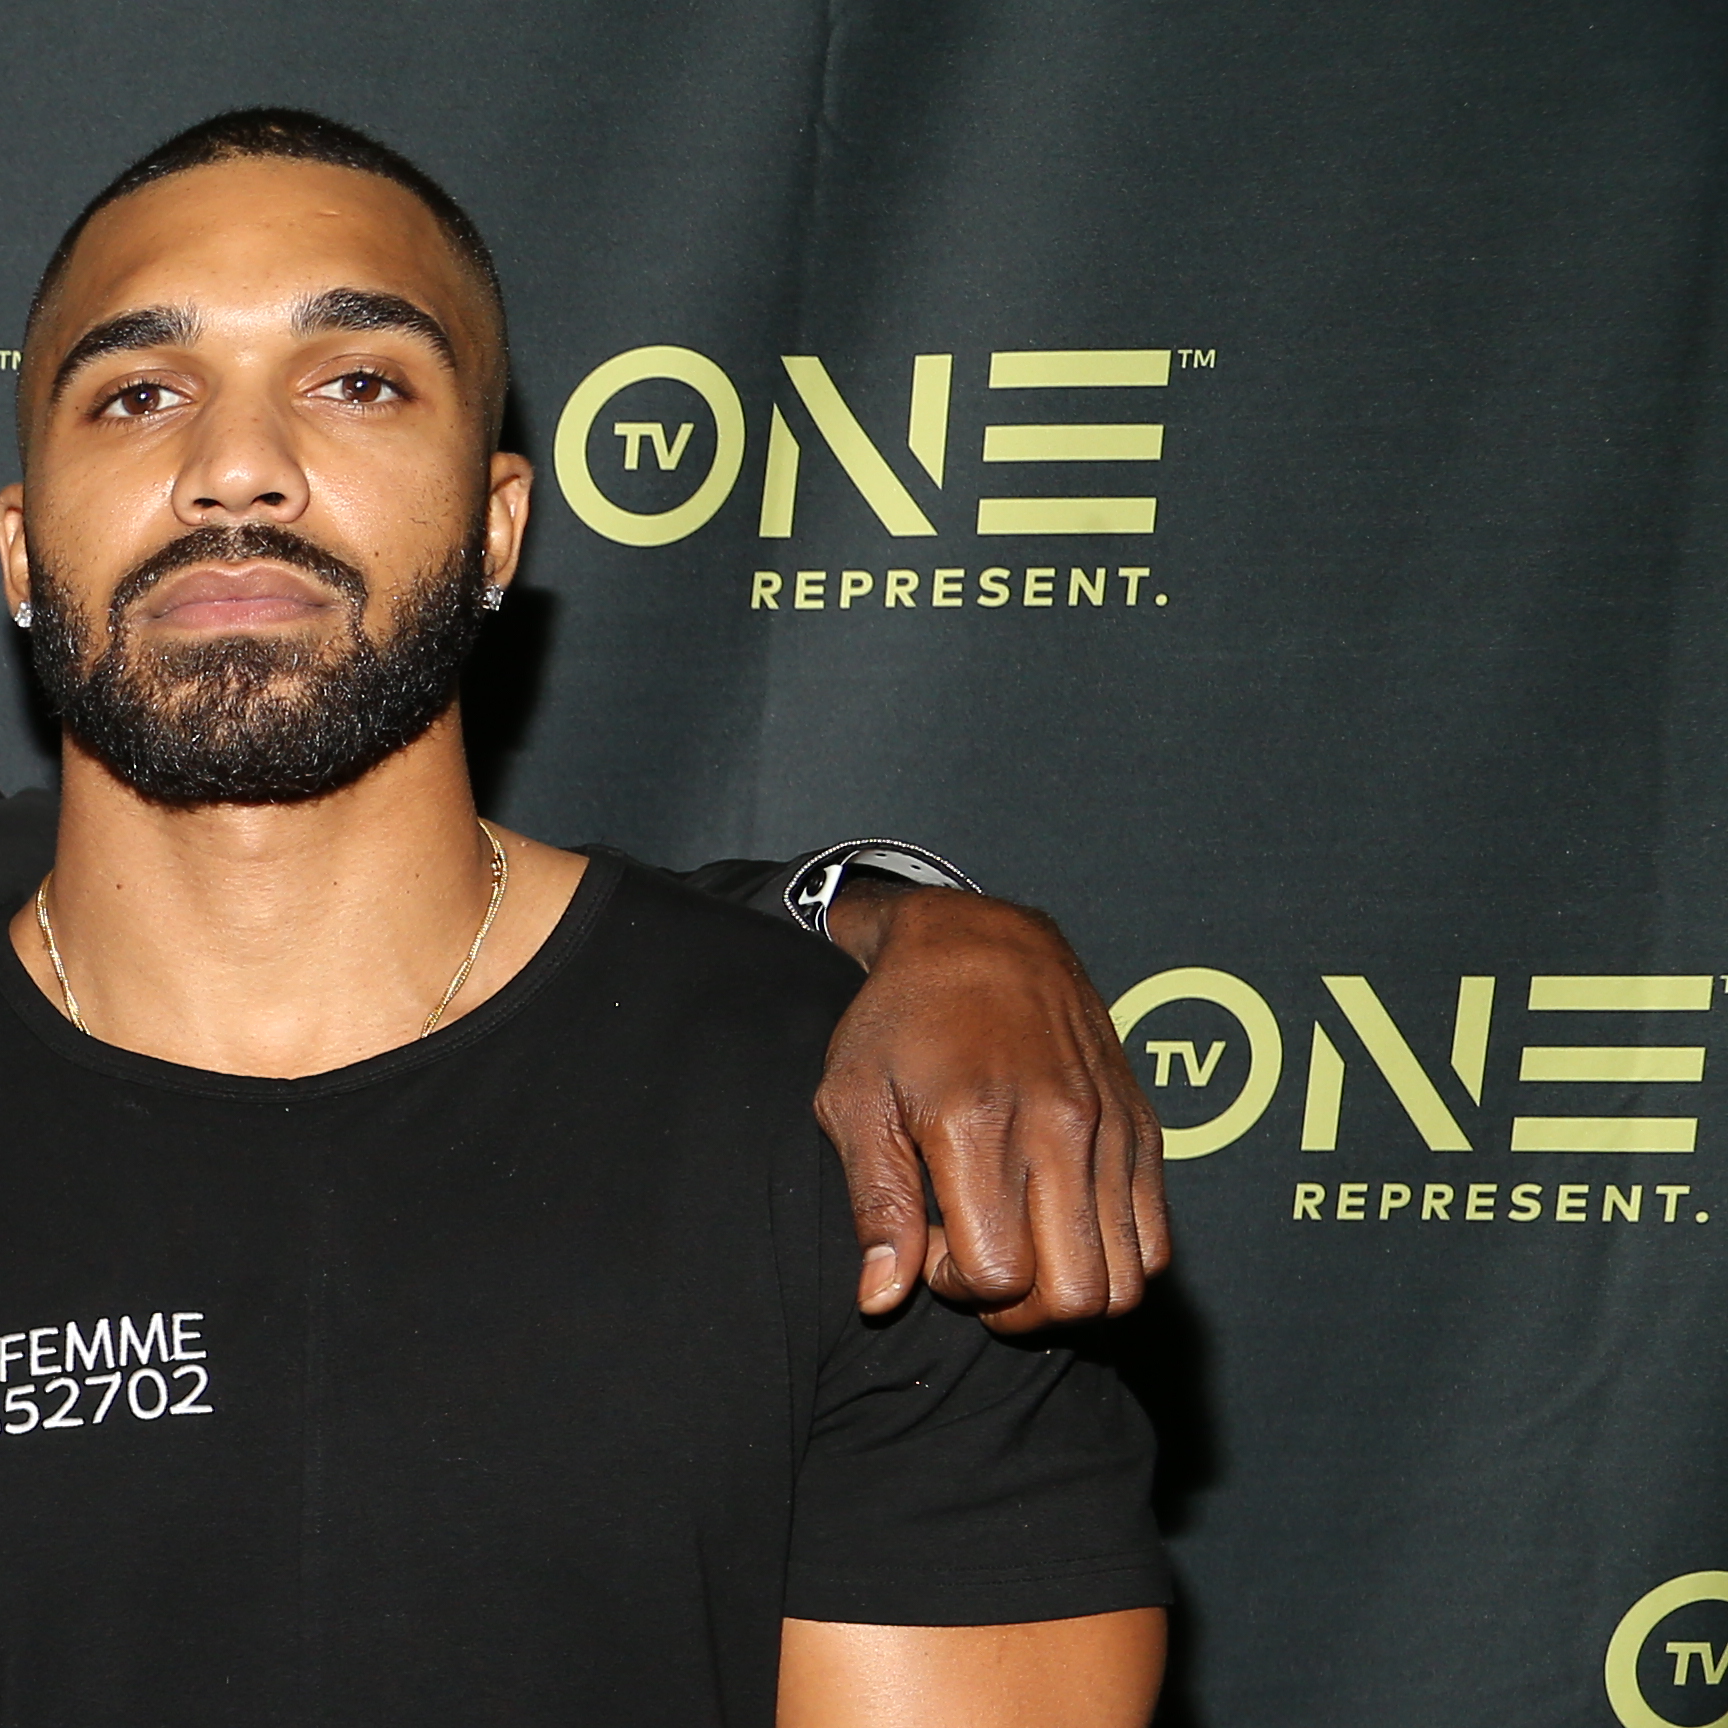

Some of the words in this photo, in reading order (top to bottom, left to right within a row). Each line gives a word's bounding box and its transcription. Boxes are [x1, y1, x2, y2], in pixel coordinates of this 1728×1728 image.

[553, 344, 1172, 547] ONE
[613, 421, 695, 471] TV
[750, 566, 1168, 610] REPRESENT.
[1145, 1040, 1227, 1087] TV
[1292, 1182, 1710, 1223] REPRESENT.
